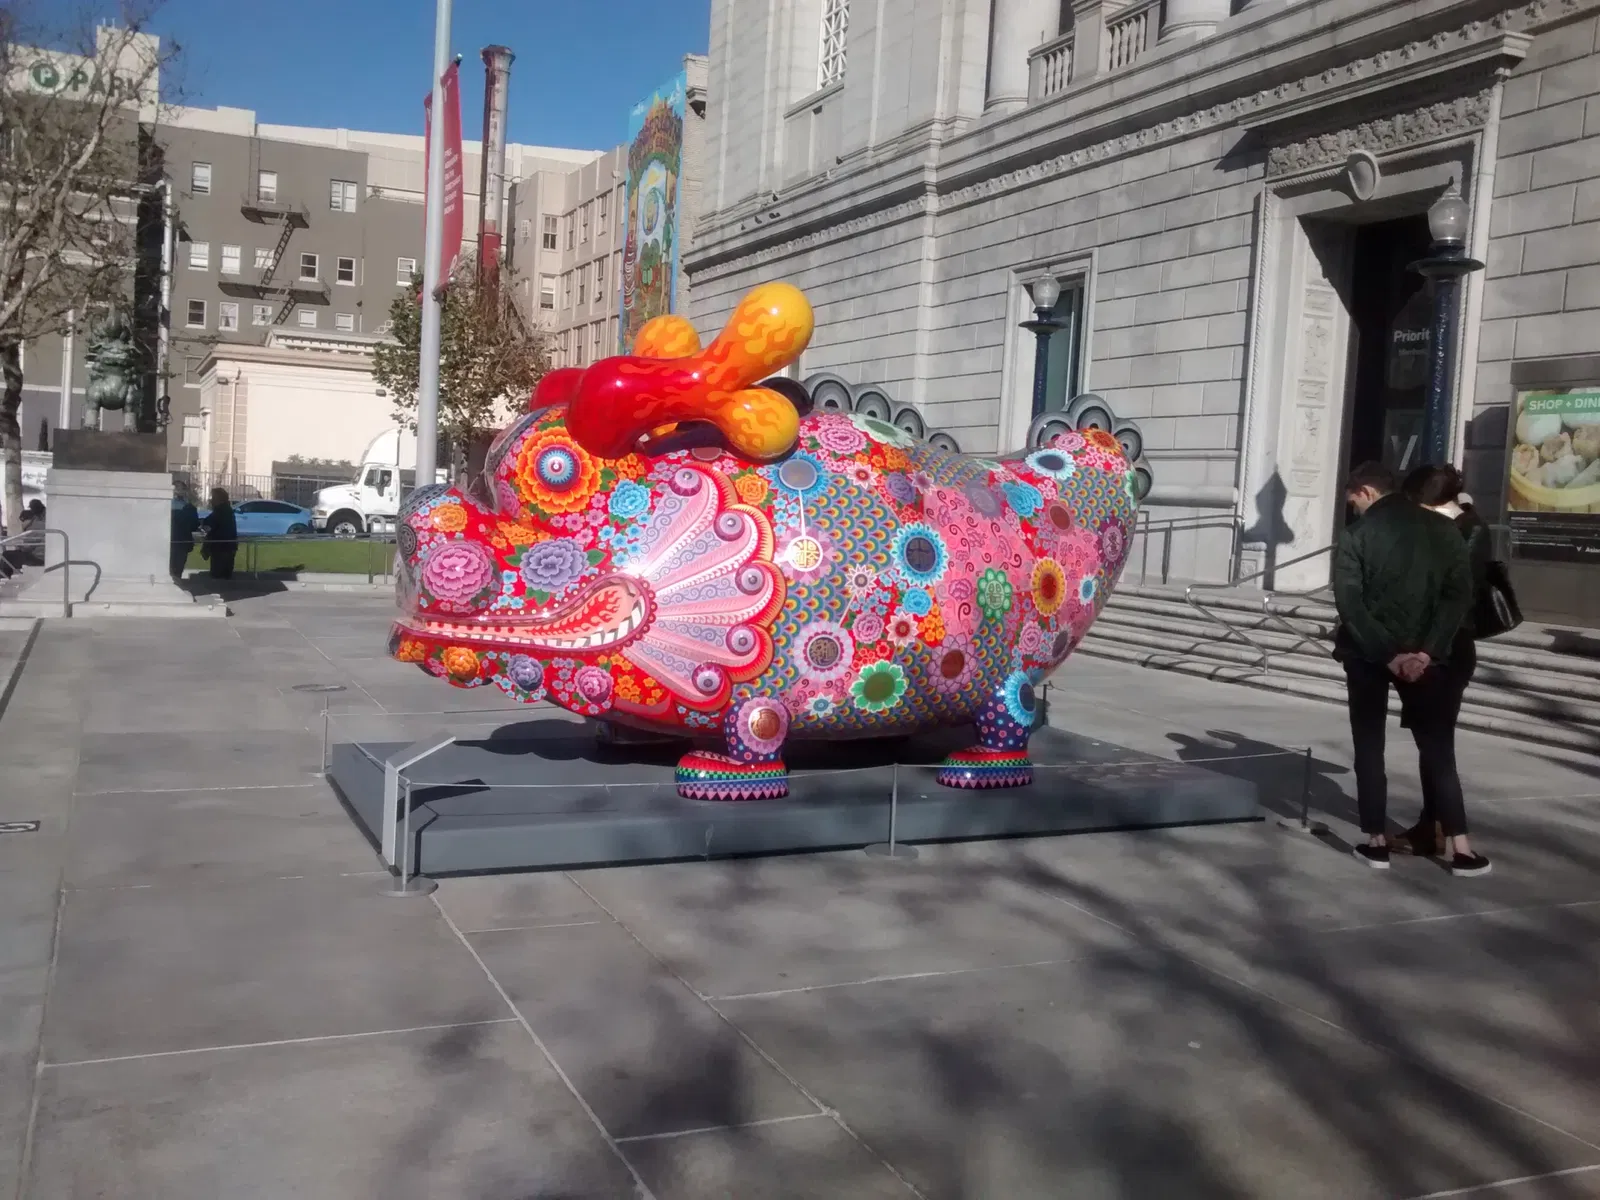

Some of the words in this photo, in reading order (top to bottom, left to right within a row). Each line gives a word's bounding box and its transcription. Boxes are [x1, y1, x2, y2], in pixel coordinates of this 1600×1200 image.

[71, 67, 142, 103] PARK
[1393, 328, 1431, 343] Priorit
[1528, 399, 1563, 411] SHOP
